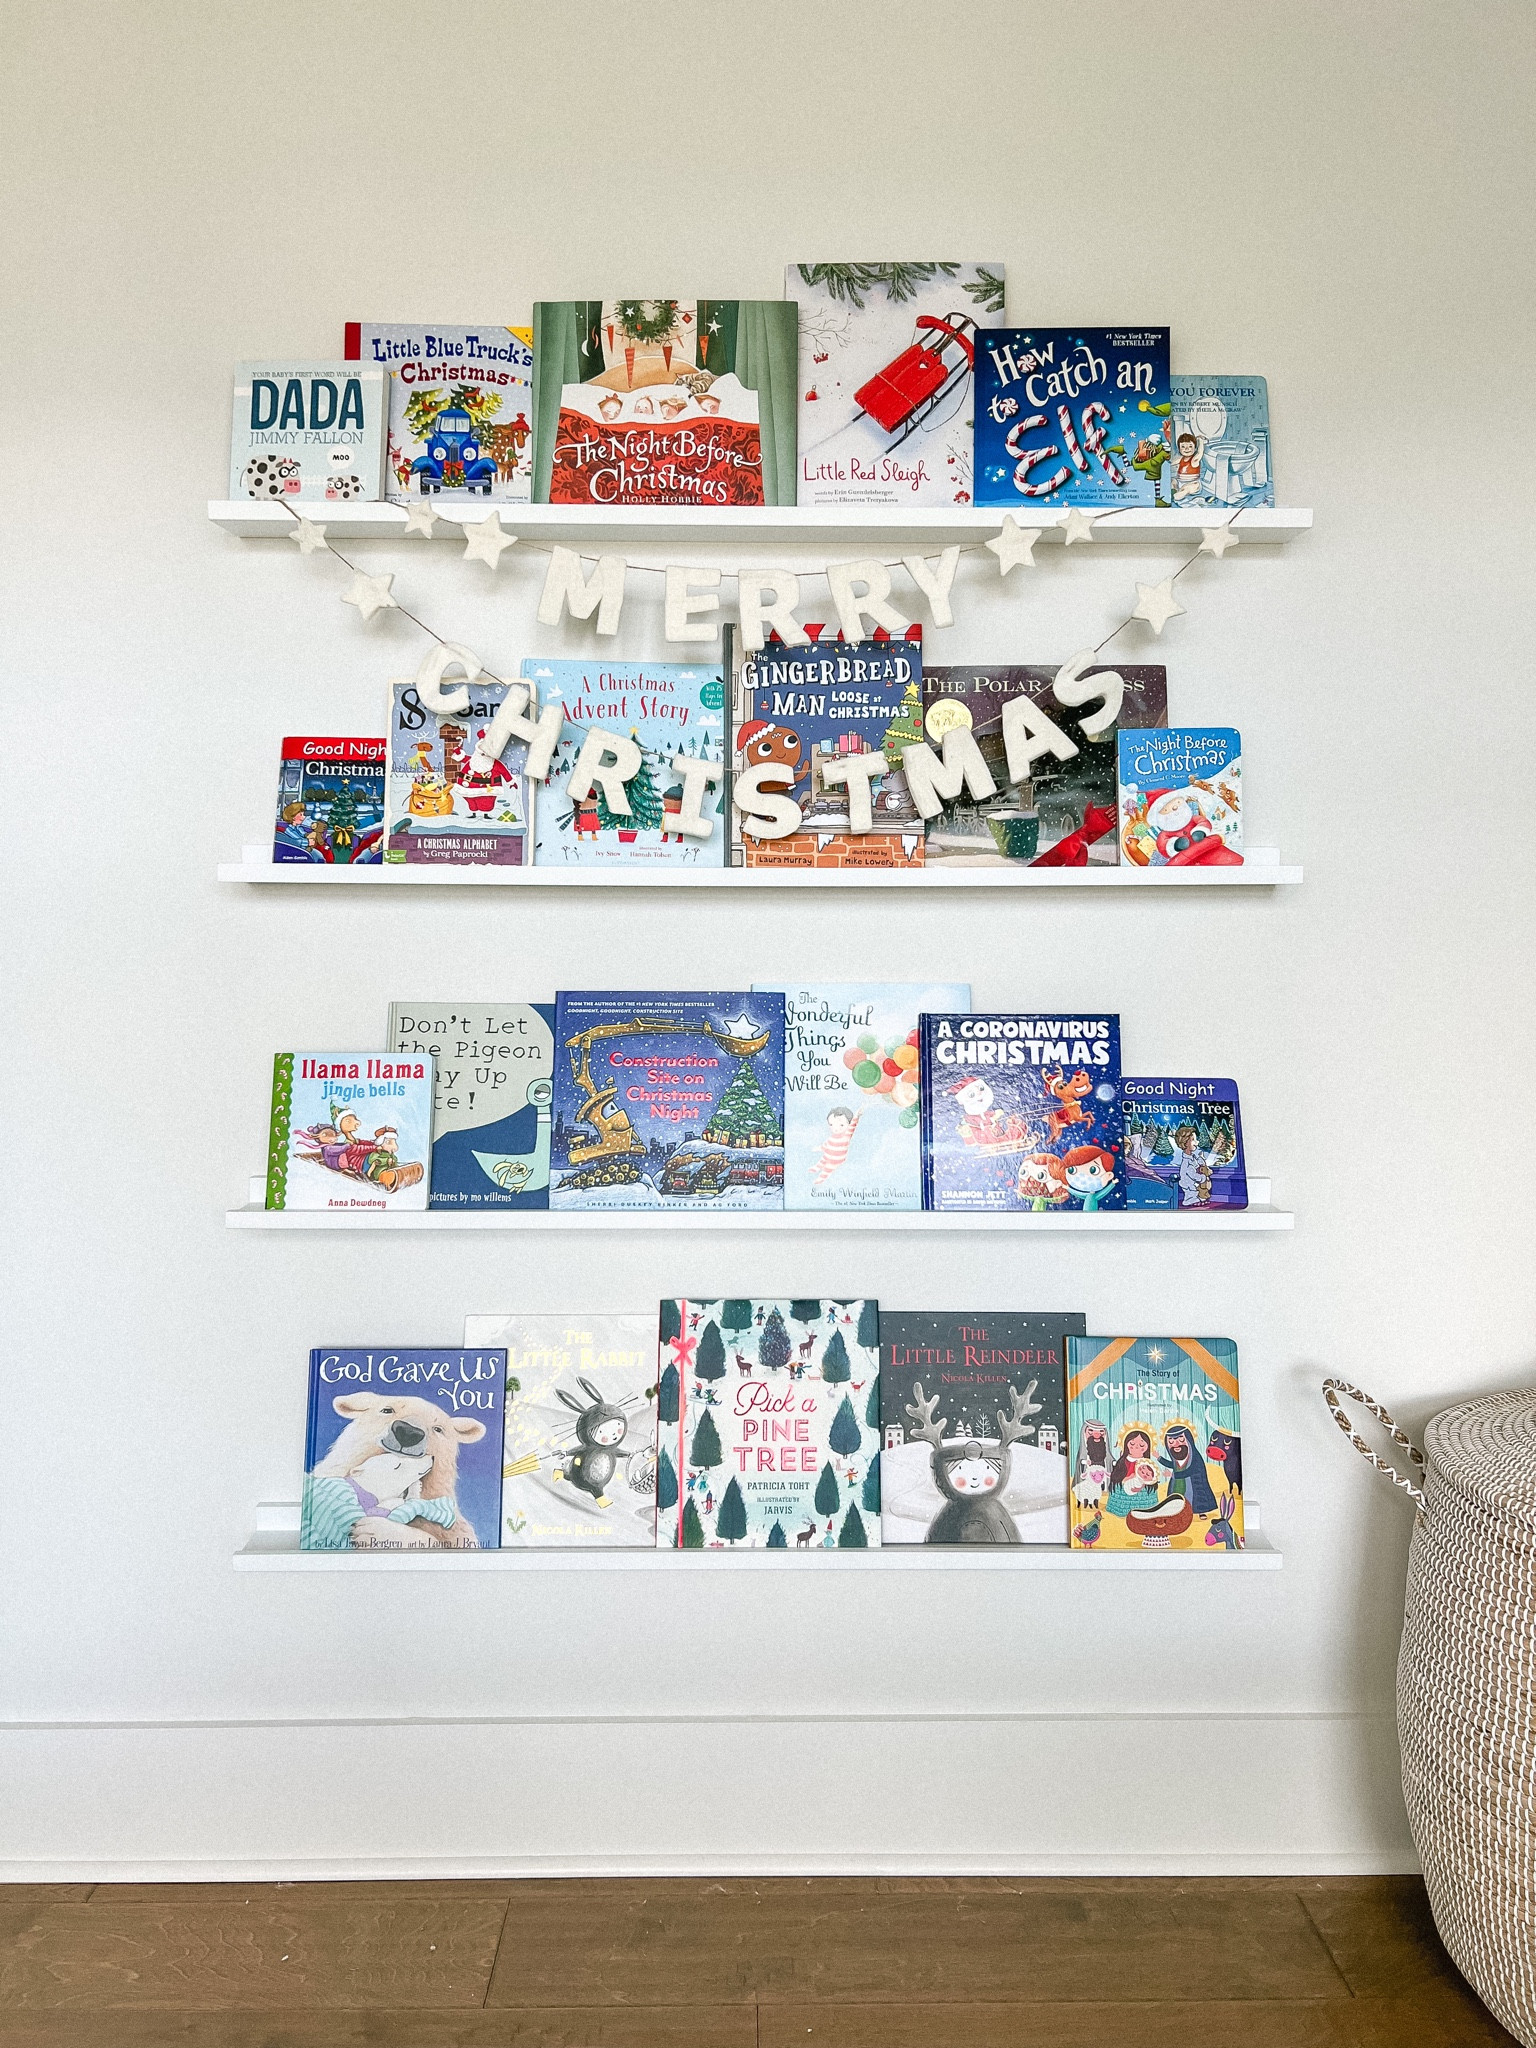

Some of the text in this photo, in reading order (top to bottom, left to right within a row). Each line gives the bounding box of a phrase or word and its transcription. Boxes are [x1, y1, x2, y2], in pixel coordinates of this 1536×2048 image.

[1128, 332, 1142, 340] York
[372, 335, 533, 367] Little Blue Truck's
[988, 341, 1054, 388] How
[400, 362, 510, 386] Christmas
[987, 345, 1157, 423] to Catch an
[1170, 387, 1256, 397] YOU FOREVER
[250, 378, 365, 430] DADA
[249, 431, 364, 446] JIMMY FALLON
[552, 430, 763, 473] The Night Before
[1005, 401, 1125, 497] Elf
[589, 461, 728, 503] Christmas
[804, 458, 931, 491] Little Red Sleigh
[622, 495, 702, 503] HOLLY HOBBIE
[537, 545, 960, 651] MERRY
[751, 652, 768, 662] The
[741, 656, 912, 690] GINGERBREAD
[582, 673, 676, 694] A Christmas
[922, 677, 966, 693] THE
[972, 677, 1043, 692] POLAR
[639, 696, 690, 726] Story
[772, 690, 883, 717] MAN LOOSE at
[828, 705, 910, 719] CHRISTMAS
[302, 741, 386, 760] Good Nigh
[416, 642, 1125, 841] CHRISTMAS
[1128, 734, 1228, 754] The Night Before
[305, 761, 385, 776] Christma
[1134, 750, 1227, 775] Christmas
[417, 838, 498, 850] A CHRISTMAS ALPHABET
[430, 849, 451, 859] Greg
[452, 850, 488, 859] Paprocki
[758, 856, 812, 866] Laura Murray
[844, 858, 894, 867] Mike Lowery
[799, 992, 818, 1004] The
[399, 1015, 528, 1034] Don't Let
[938, 1021, 1110, 1039] A CORONAVIRUS
[784, 1025, 846, 1052] Things
[398, 1040, 542, 1064] the Pigeon
[609, 1051, 719, 1068] Construction
[797, 1050, 832, 1072] You
[936, 1040, 1110, 1066] CHRISTMAS
[301, 1059, 359, 1080] llama
[366, 1059, 425, 1080] llama
[647, 1070, 704, 1084] Site on
[475, 1067, 508, 1091] Up
[784, 1074, 849, 1092] Will Be
[321, 1080, 406, 1100] jingle bells
[626, 1086, 713, 1102] Christmas
[1124, 1082, 1216, 1099] Good Night
[434, 1092, 476, 1110] te!
[1122, 1100, 1230, 1114] Christmas Tree
[650, 1104, 700, 1123] Night
[430, 1192, 512, 1204] pictures by mo willems
[810, 1187, 836, 1200] Emily
[942, 1190, 1006, 1200] SHANNON JETT
[328, 1198, 386, 1208] Anna Dewdney
[564, 1329, 594, 1346] THE
[958, 1326, 990, 1342] THE
[508, 1347, 646, 1370] LITTLE RABBIT
[890, 1344, 1060, 1367] LITTLE REINDEER
[319, 1355, 374, 1384] God
[378, 1356, 454, 1384] Gave
[941, 1373, 1008, 1384] NICOLA KILLEN
[1152, 1370, 1171, 1378] Story
[437, 1380, 495, 1412] You
[734, 1382, 818, 1416] Pick a
[743, 1419, 810, 1442] PINE
[732, 1446, 818, 1472] TREE
[747, 1482, 810, 1490] PATRICIA TOHT
[764, 1506, 793, 1516] JARVIS
[531, 1524, 614, 1536] NICOLA KILLEN
[369, 1538, 403, 1549] Bergren
[407, 1540, 418, 1548] art
[418, 1539, 426, 1549] by
[462, 1538, 491, 1549] Bryant
